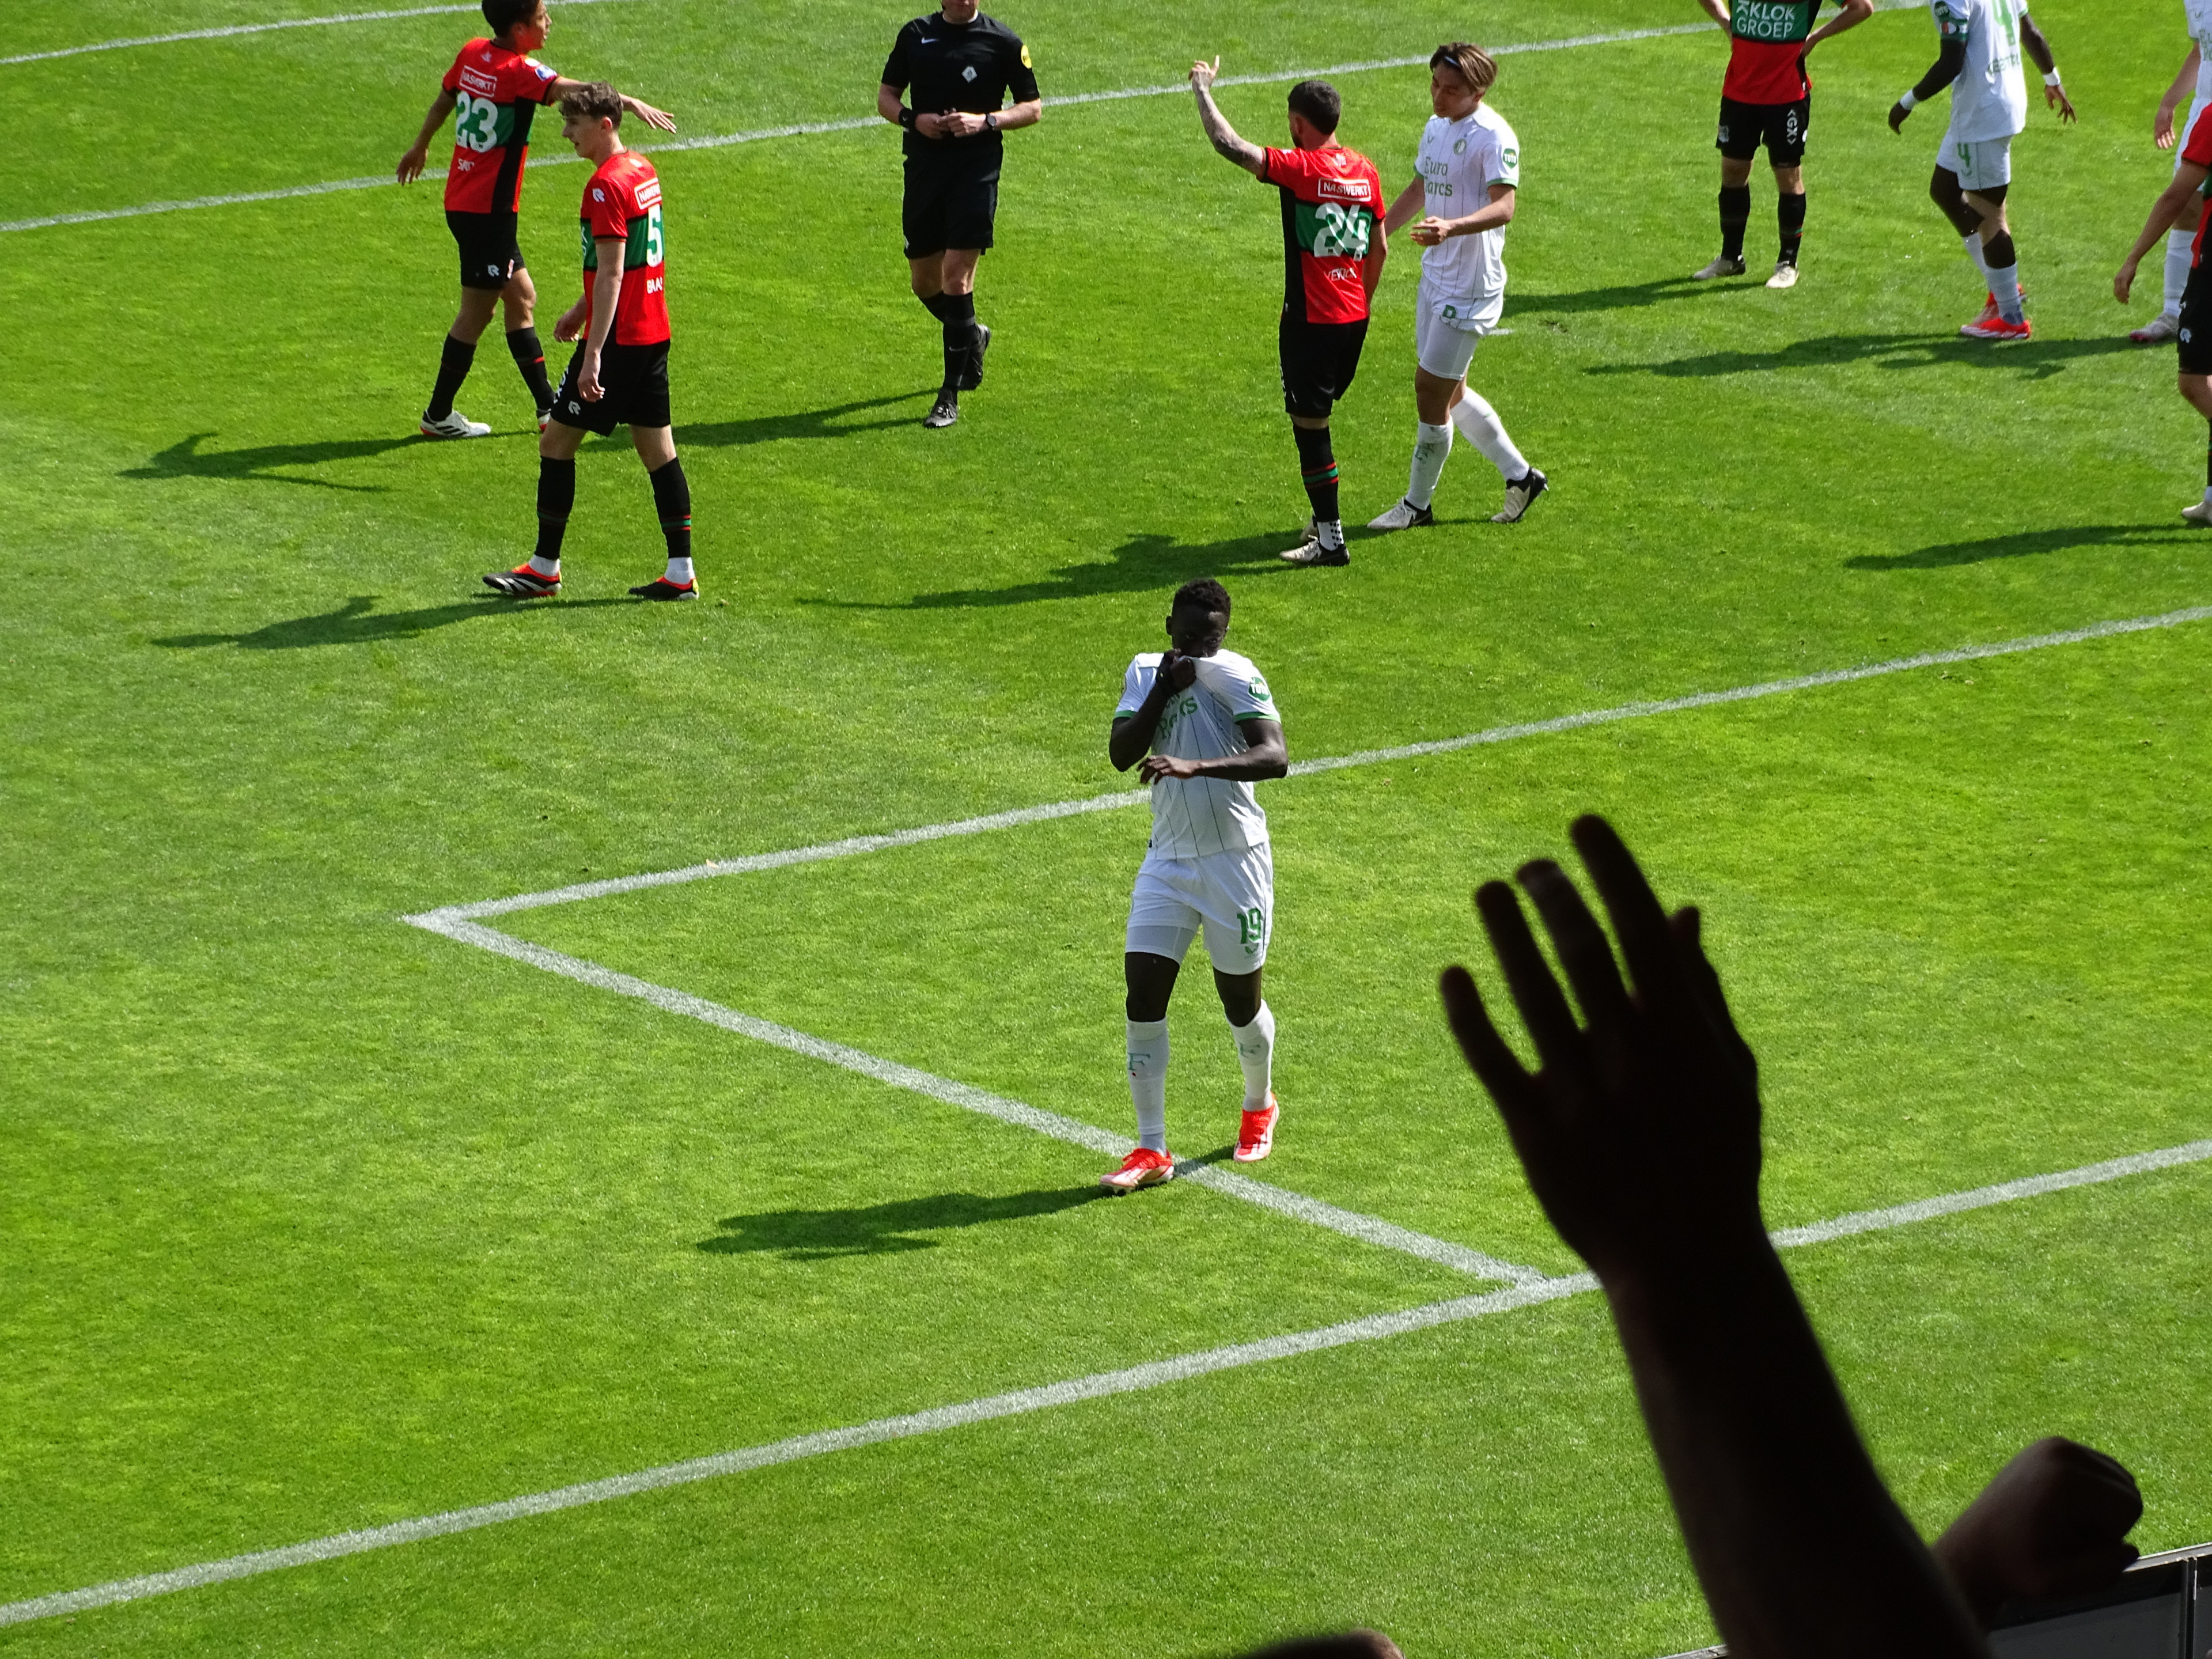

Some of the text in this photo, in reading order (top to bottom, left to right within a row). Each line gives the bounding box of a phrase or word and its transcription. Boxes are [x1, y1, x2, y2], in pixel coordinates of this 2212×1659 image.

[1736, 17, 1794, 39] GROEP
[456, 90, 498, 153] 23
[1504, 153, 1517, 164] TOTO
[1323, 181, 1368, 196] NASWERKT
[646, 203, 663, 268] 5
[1313, 202, 1366, 262] 24
[1251, 683, 1270, 696] TOTO
[1236, 908, 1262, 945] 19
